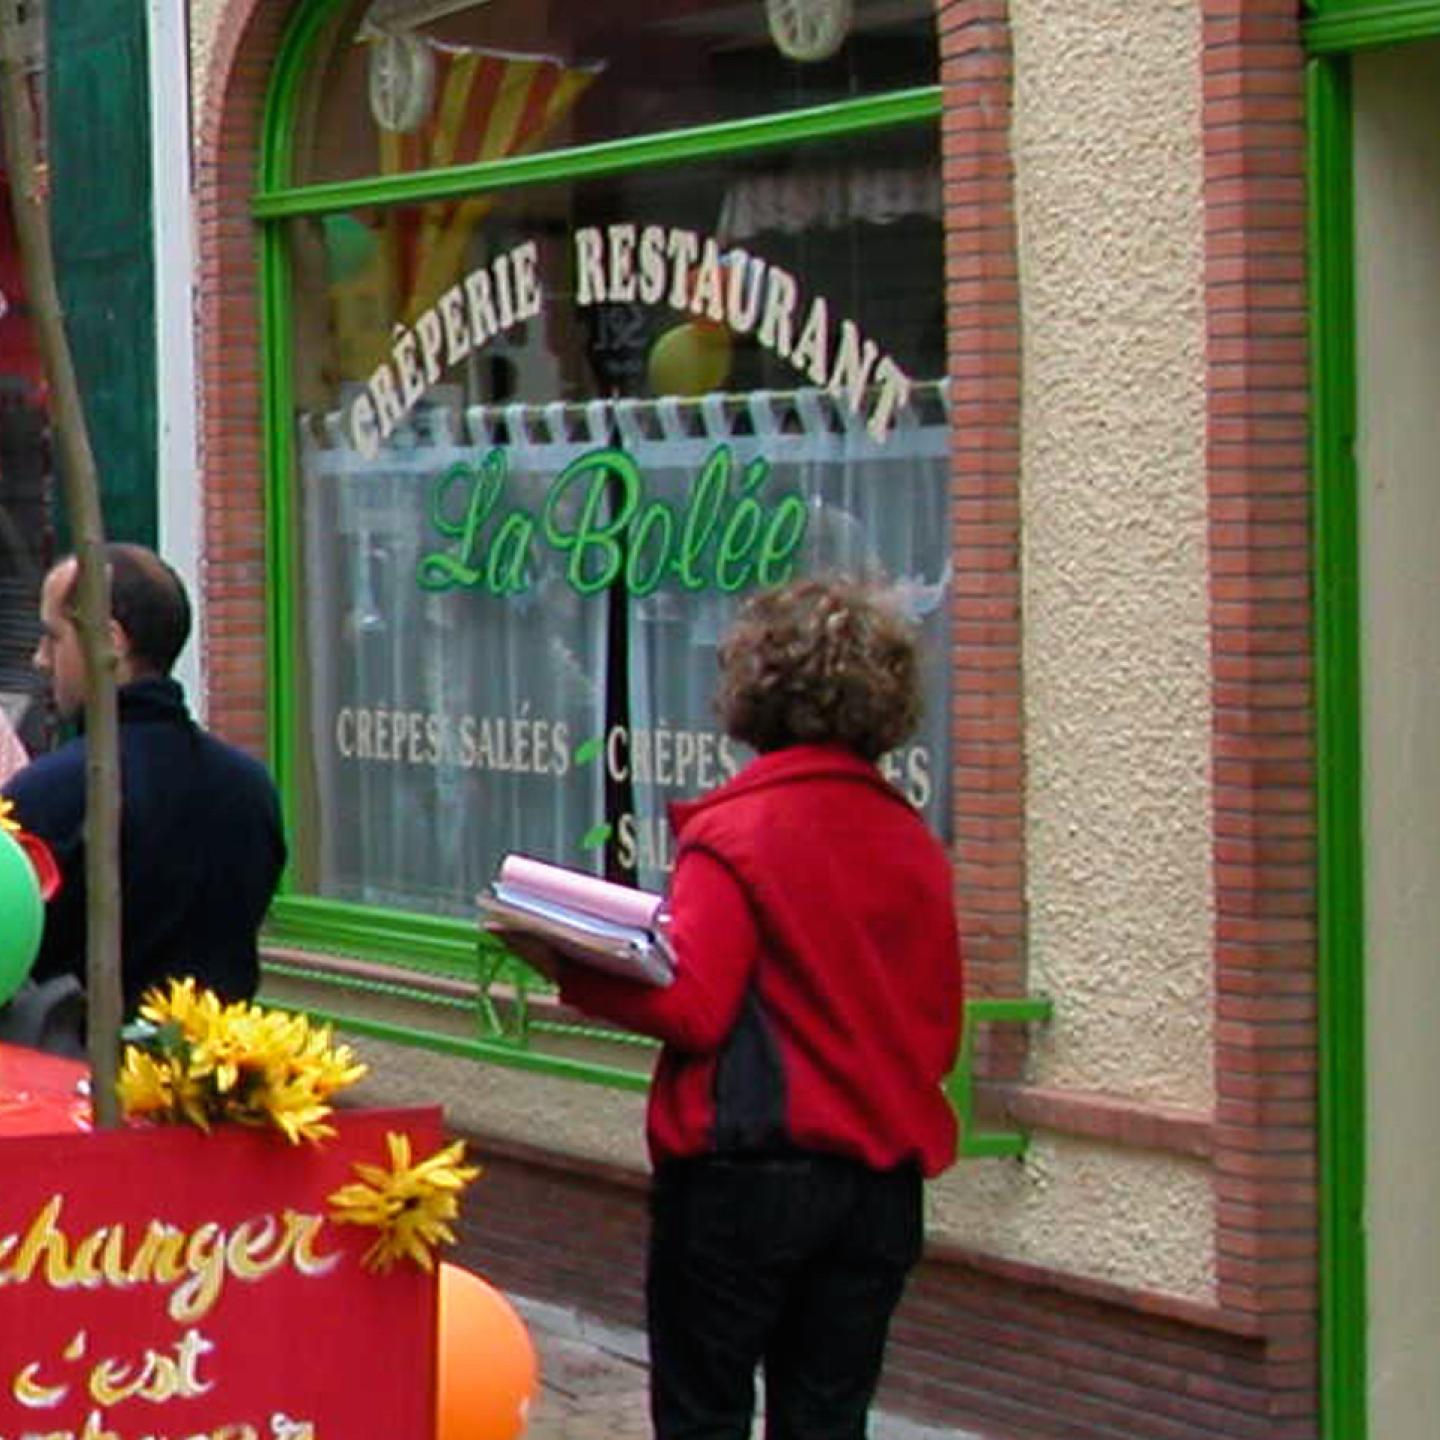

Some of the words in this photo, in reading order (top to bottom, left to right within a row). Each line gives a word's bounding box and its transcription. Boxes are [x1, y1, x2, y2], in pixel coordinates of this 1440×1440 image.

[350, 241, 544, 460] CRÊPERIE
[574, 224, 910, 444] RESTAURANT
[416, 448, 534, 595] La
[544, 444, 806, 596] Bolée
[459, 700, 570, 776] SALÉES
[12, 1328, 216, 1408] c'est
